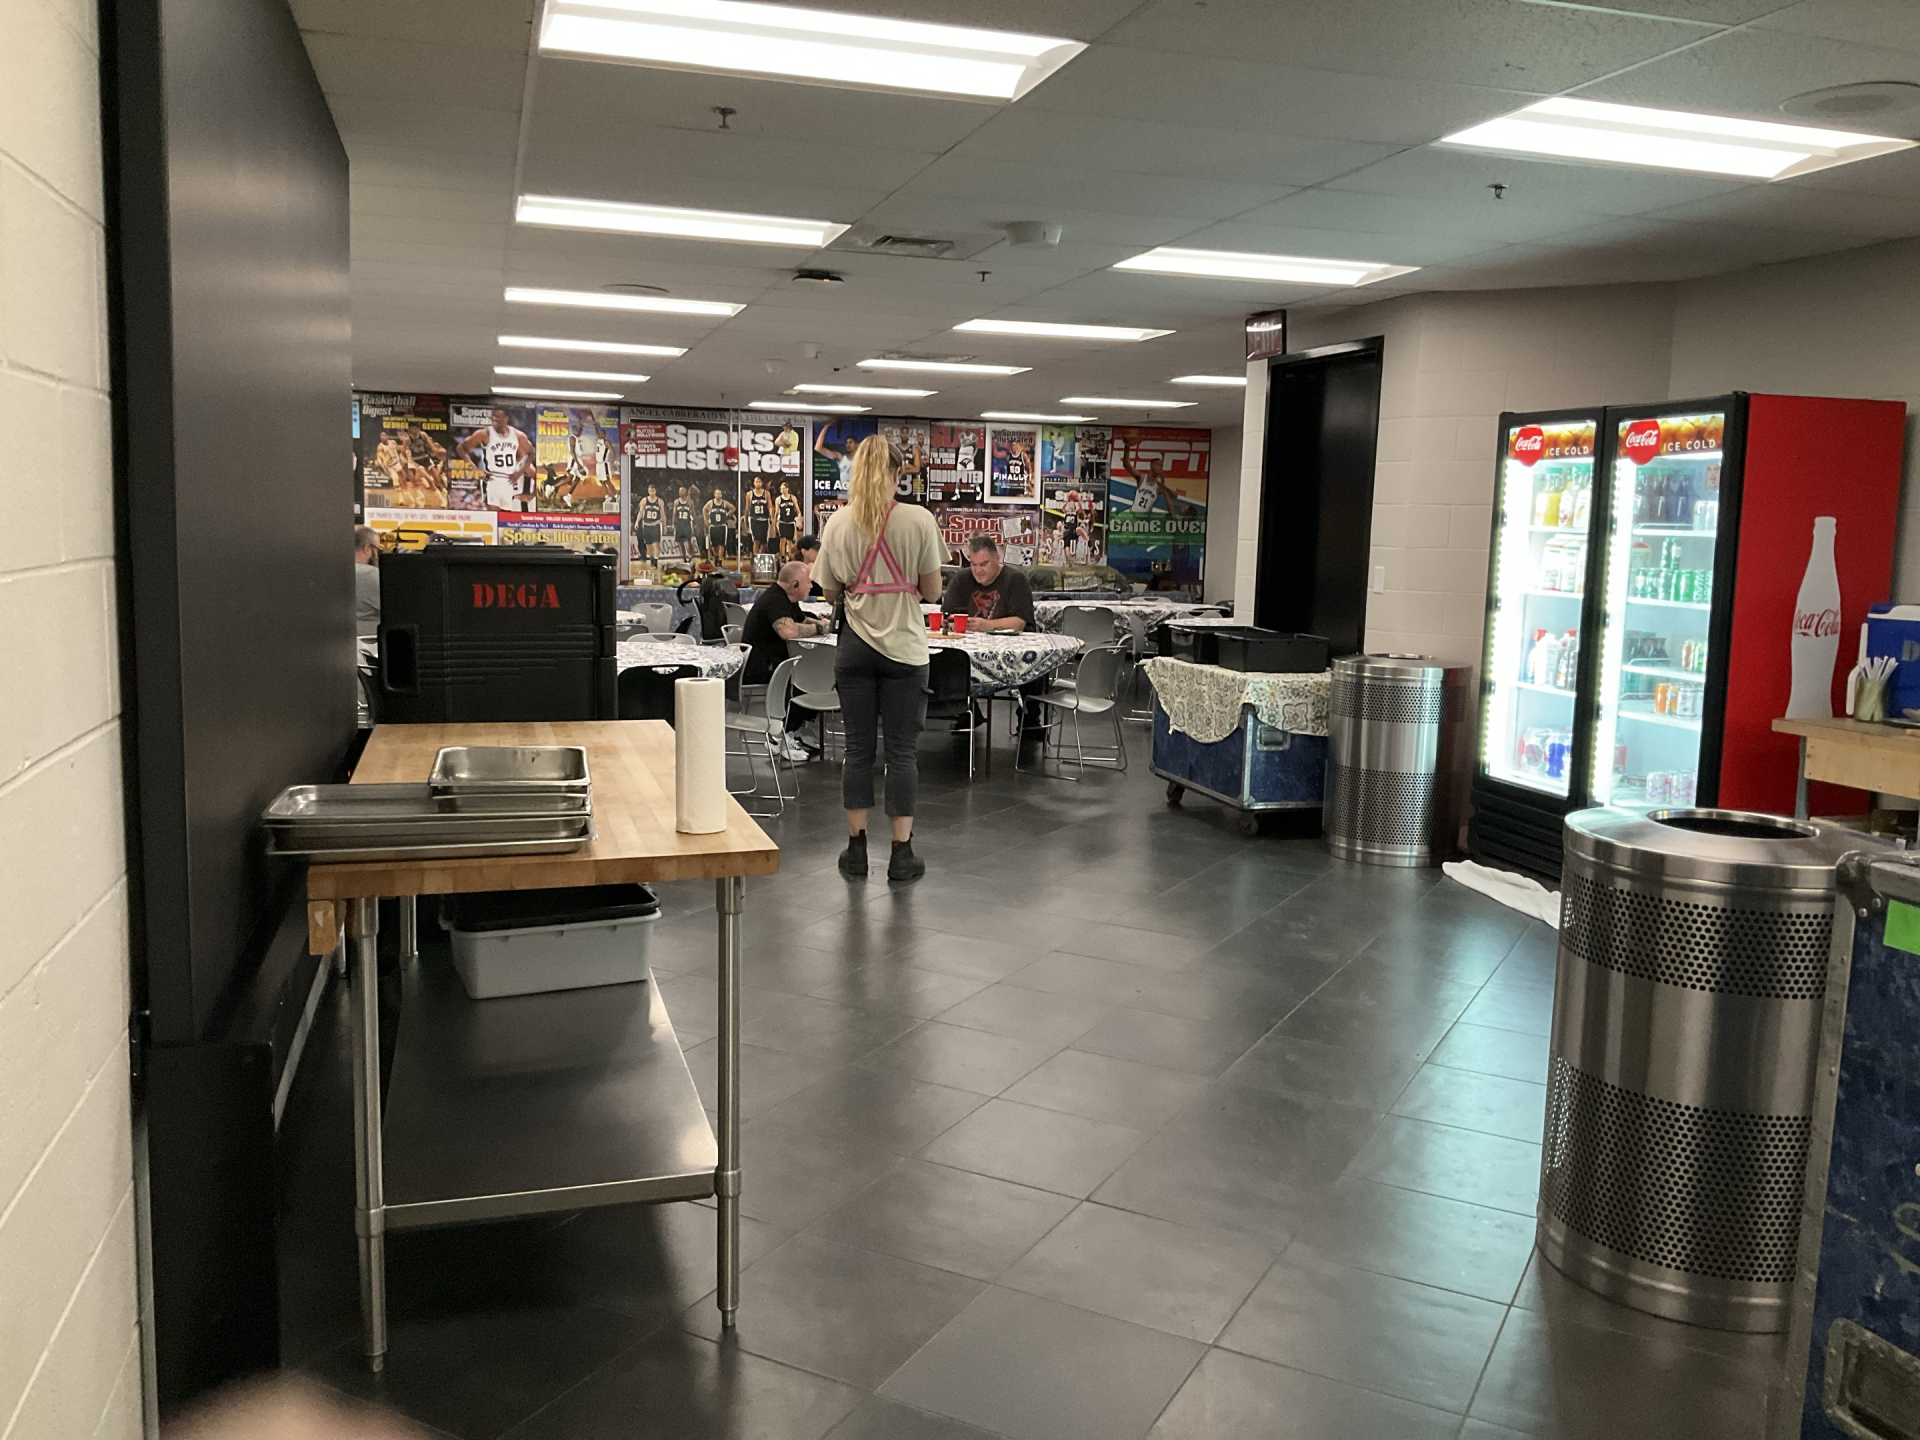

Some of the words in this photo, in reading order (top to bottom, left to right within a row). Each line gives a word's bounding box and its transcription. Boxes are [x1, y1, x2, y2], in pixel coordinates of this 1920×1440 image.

[362, 394, 416, 406] Basketball
[362, 405, 392, 418] Digest
[461, 407, 493, 418] Sports
[663, 409, 706, 419] CABRERA
[453, 413, 493, 425] Illustrat
[382, 421, 409, 430] GEORGE
[422, 422, 447, 431] GERVIN
[666, 424, 774, 451] Sports
[1001, 429, 1027, 437] Sports
[1626, 429, 1659, 448] Coca-Cola
[490, 441, 518, 453] SPURS
[1515, 435, 1543, 451] Coca-Cola
[1664, 442, 1681, 452] ICE
[1686, 439, 1716, 450] COLD
[1545, 447, 1560, 457] ICE
[1564, 446, 1589, 456] COLD
[494, 453, 514, 467] 50
[451, 469, 485, 479] MVP
[1010, 466, 1020, 474] 50
[993, 473, 1033, 481] FINALLY!
[815, 480, 831, 490] ICE
[834, 480, 849, 490] AG
[1138, 497, 1149, 508] 21
[678, 511, 688, 519] 12
[754, 505, 764, 514] 21
[785, 507, 791, 516] 7
[646, 511, 657, 520] 20
[949, 515, 1003, 532] Sport
[1110, 519, 1161, 533] GAME
[503, 528, 550, 543] Sports
[553, 531, 619, 543] Illustrated
[1046, 538, 1100, 555] SPURS
[471, 583, 561, 608] DEGA
